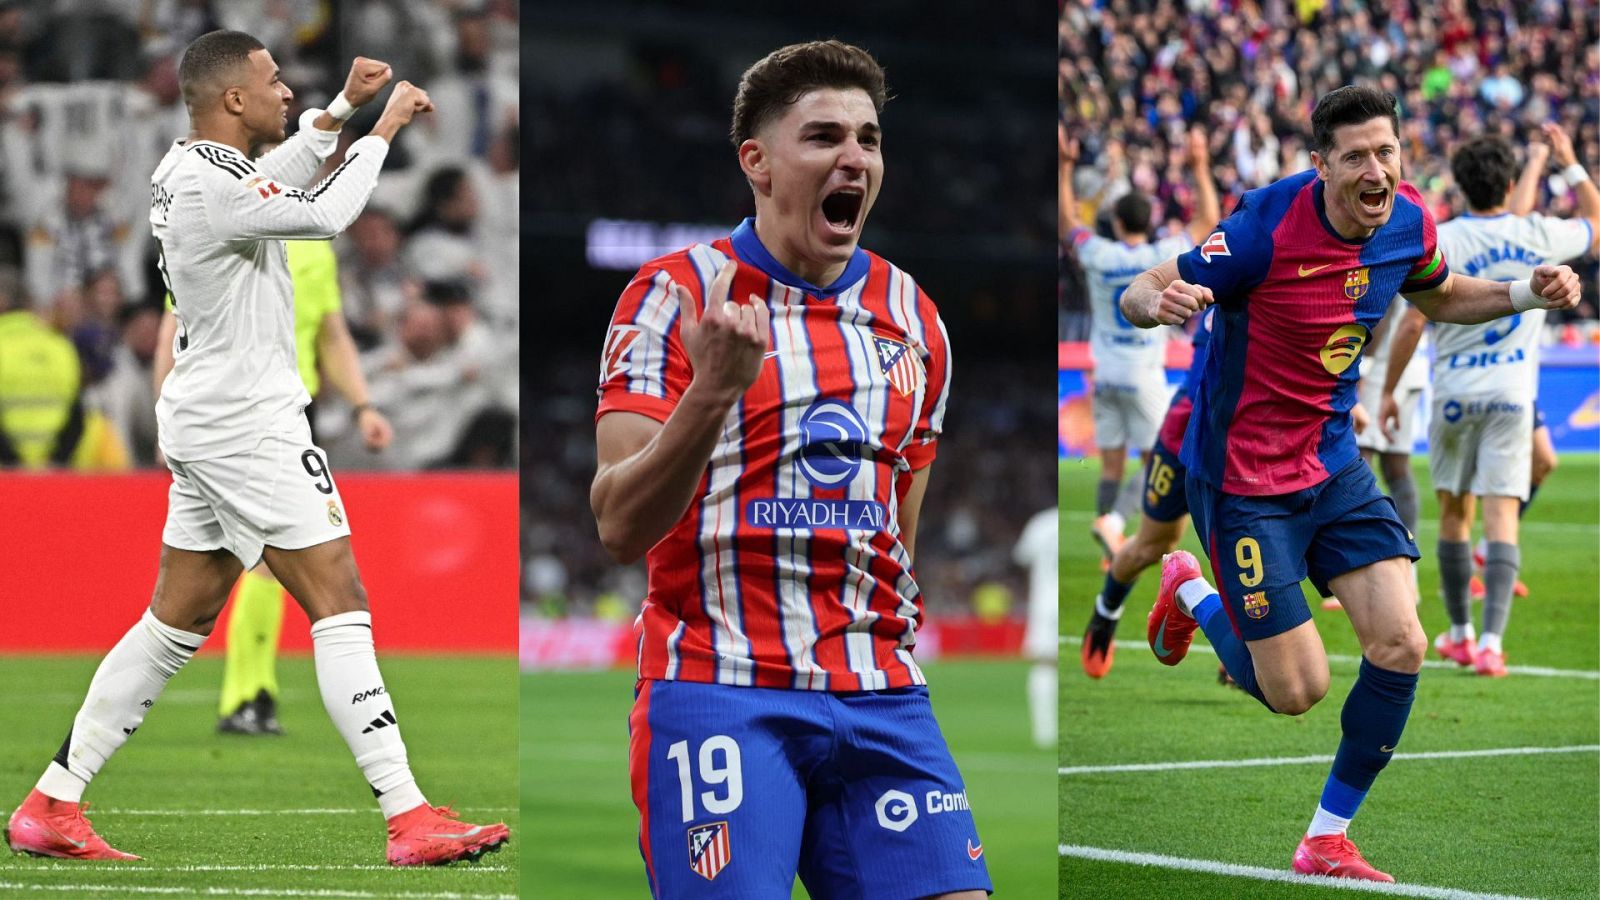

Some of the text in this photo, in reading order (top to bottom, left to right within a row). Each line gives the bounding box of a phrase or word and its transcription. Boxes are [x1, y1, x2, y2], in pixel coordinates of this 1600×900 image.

[301, 449, 333, 494] 9
[1149, 454, 1175, 496] 16
[754, 502, 849, 526] RIYADH
[1235, 537, 1264, 588] 9
[667, 735, 743, 823] 19
